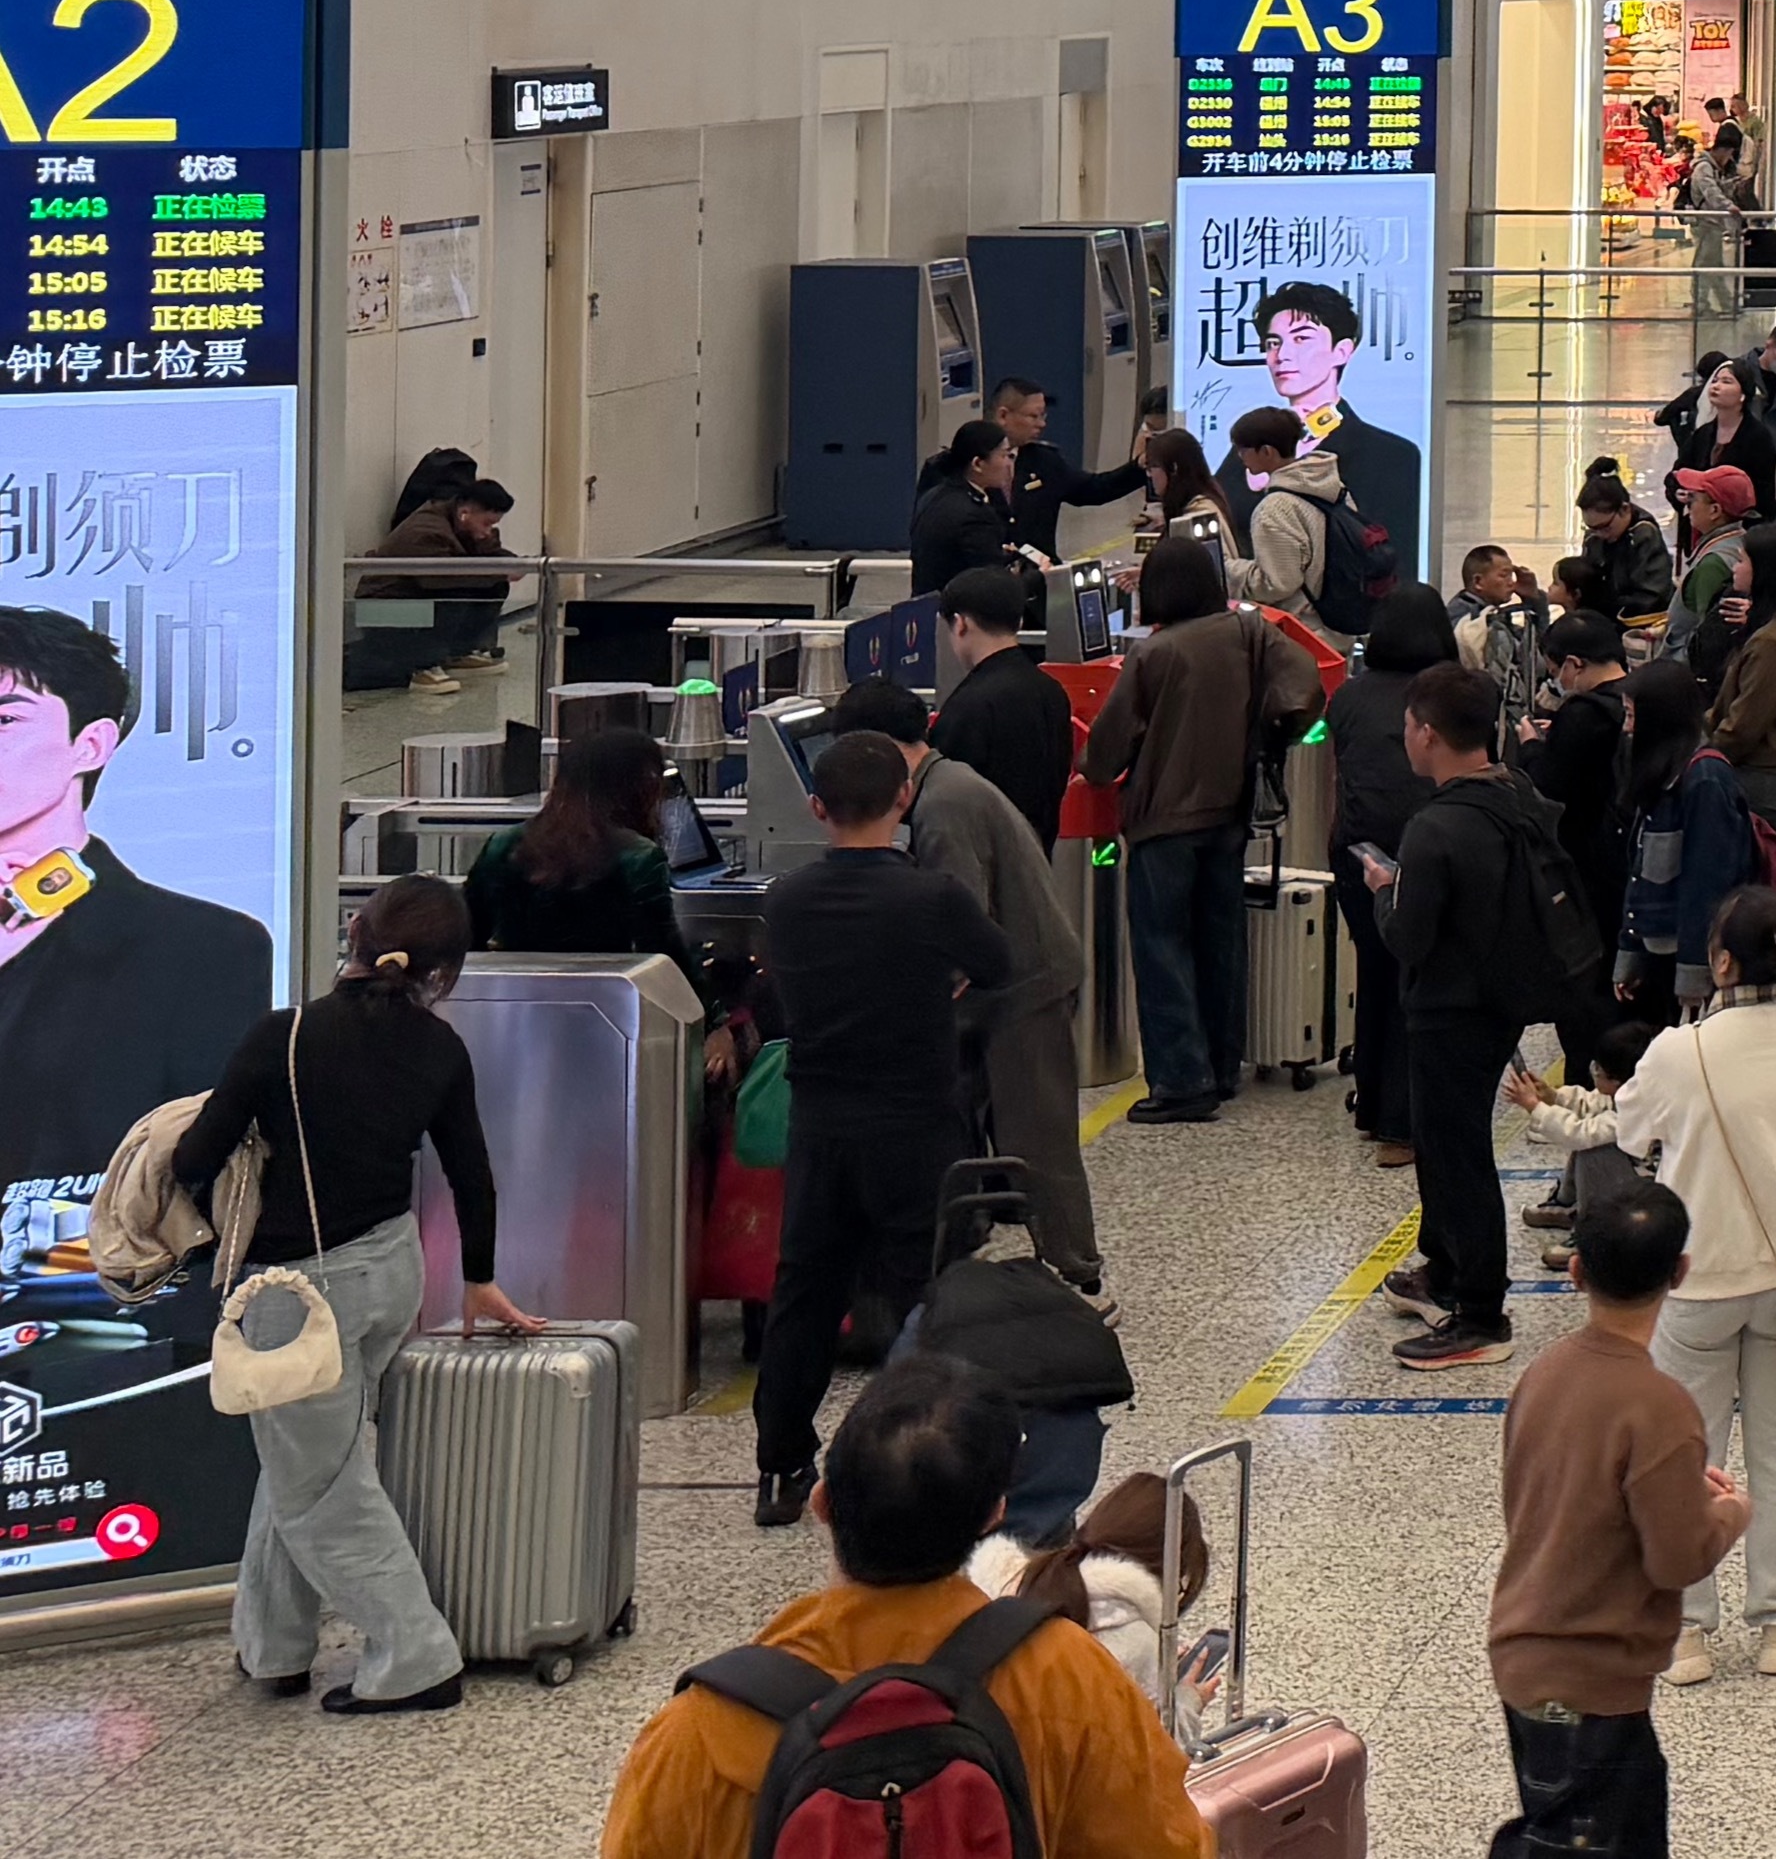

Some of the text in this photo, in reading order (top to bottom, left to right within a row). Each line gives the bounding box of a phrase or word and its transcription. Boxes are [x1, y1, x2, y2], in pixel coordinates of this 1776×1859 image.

[1690, 18, 1735, 39] TOY
[36, 155, 238, 184] 开点 状态
[1201, 149, 1413, 174] 开车前4分钟停止检票
[29, 193, 266, 221] 14:43 正在检票
[28, 229, 265, 257] 14:54 正在候车
[1200, 215, 1410, 272] 创维剃须刀
[28, 267, 265, 296] 15:05 正在候车
[27, 303, 264, 332] 15:16 正在候车
[0, 336, 250, 384] 钟停止检票
[2, 1450, 70, 1485] 新品
[7, 1479, 107, 1511] 抢先体验
